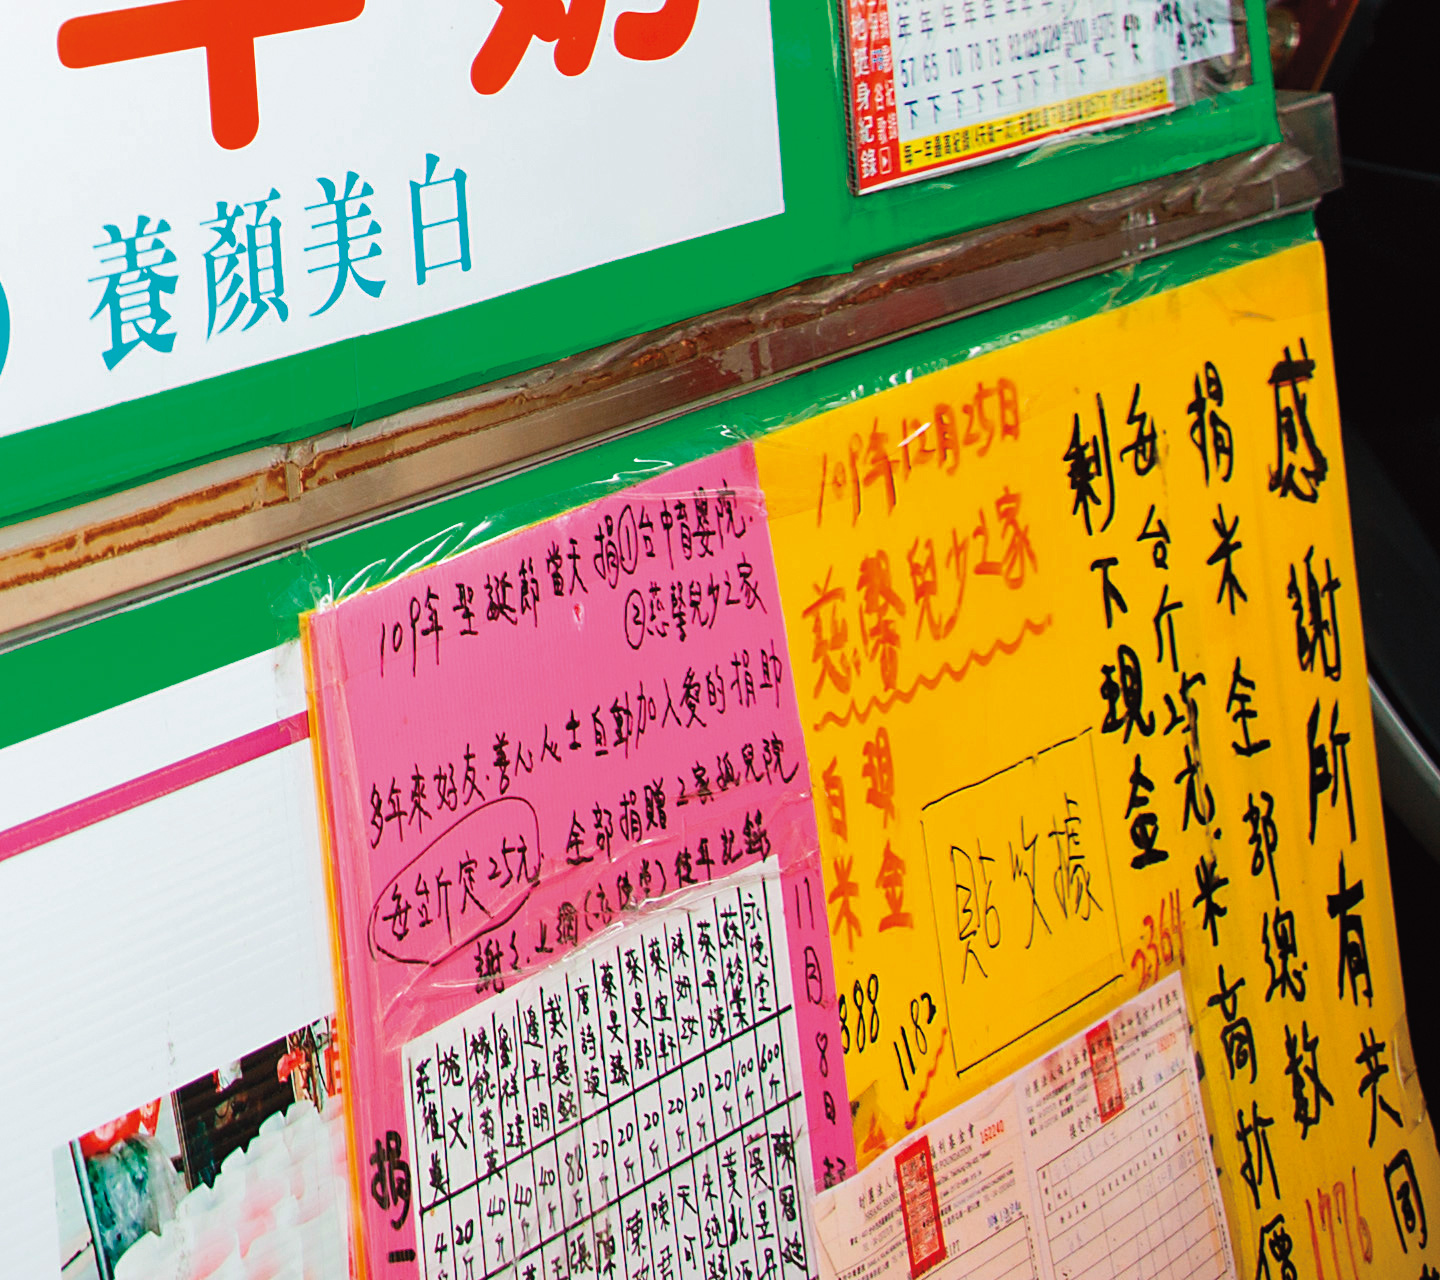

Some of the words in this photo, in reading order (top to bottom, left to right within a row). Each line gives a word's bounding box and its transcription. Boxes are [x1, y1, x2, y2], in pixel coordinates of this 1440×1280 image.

[86, 152, 473, 374] 養顏美白
[1266, 336, 1440, 1280] 感謝所有共同
